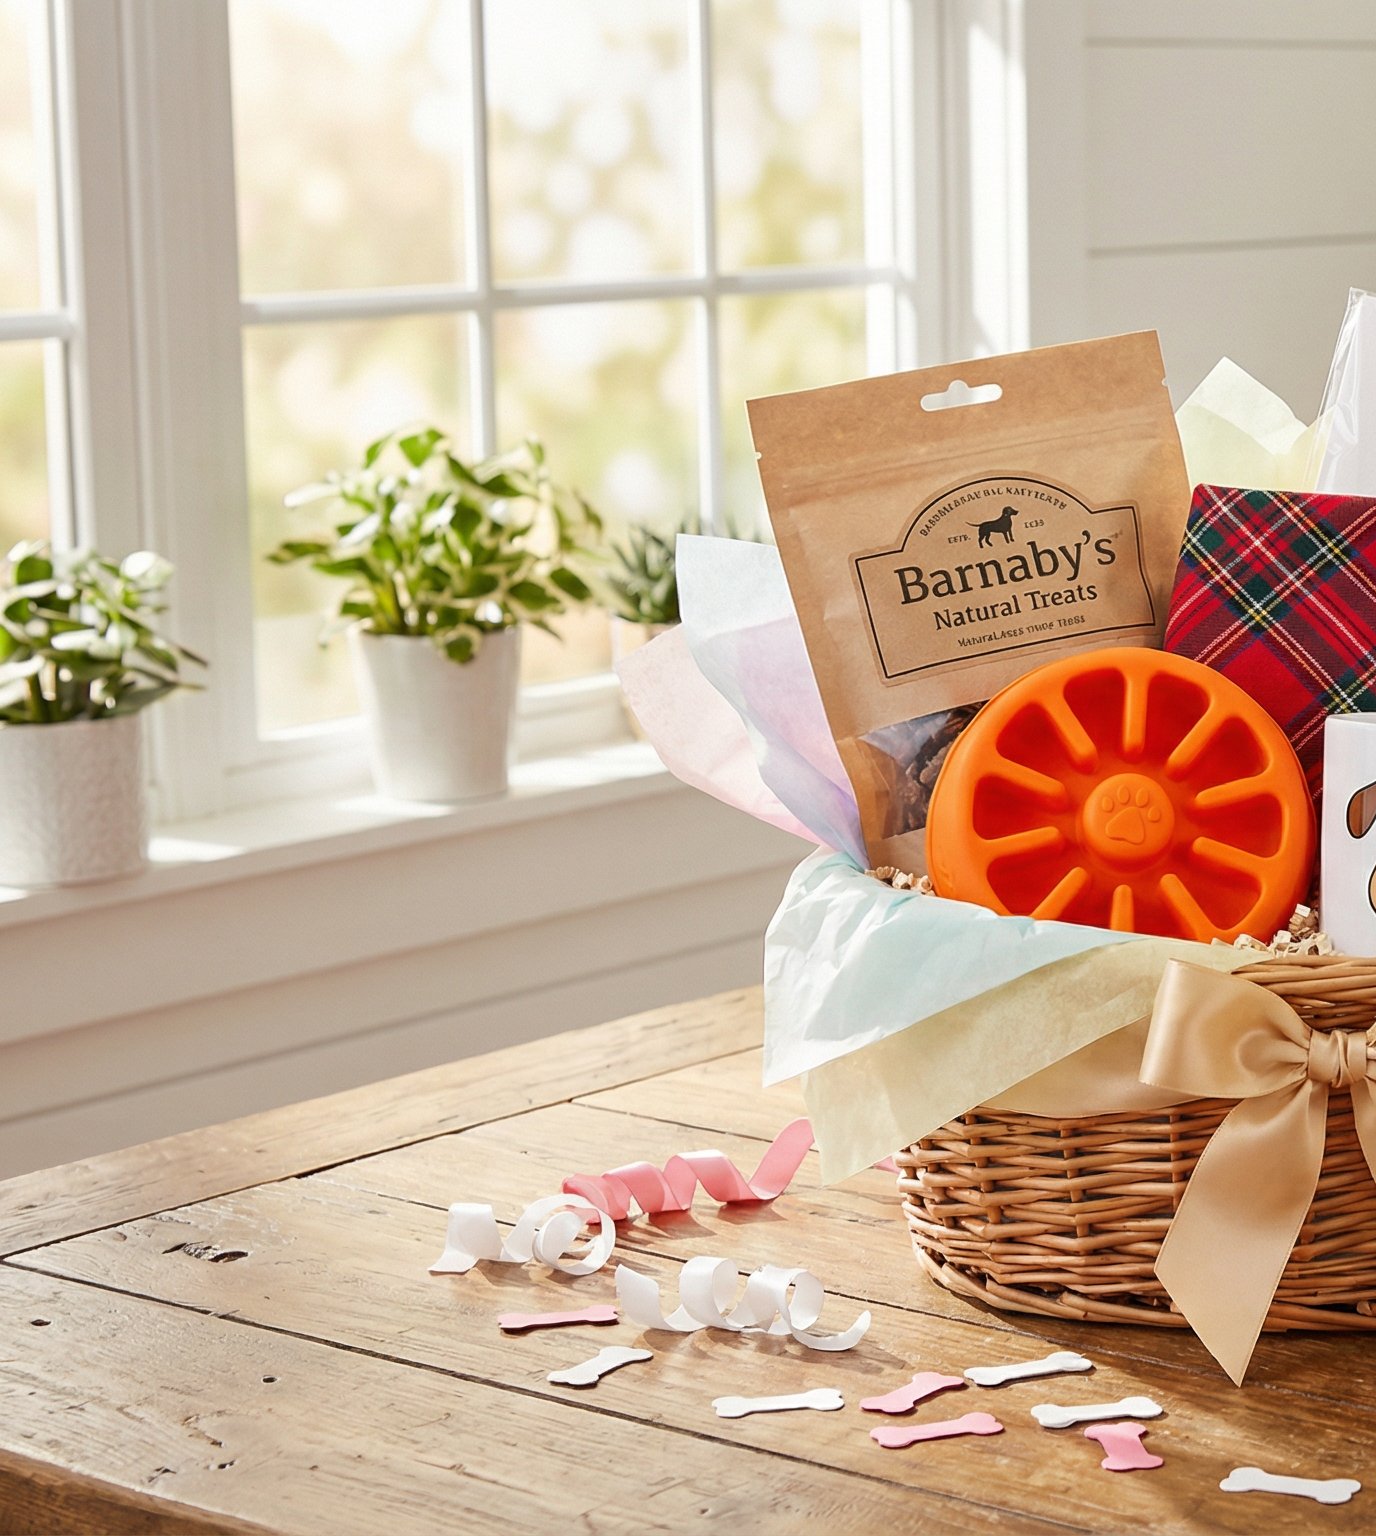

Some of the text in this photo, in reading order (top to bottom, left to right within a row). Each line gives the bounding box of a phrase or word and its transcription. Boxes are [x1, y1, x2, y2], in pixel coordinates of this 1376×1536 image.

[893, 529, 1117, 605] Barnaby's
[933, 594, 1022, 631] Natural
[1024, 584, 1099, 612] Treats
